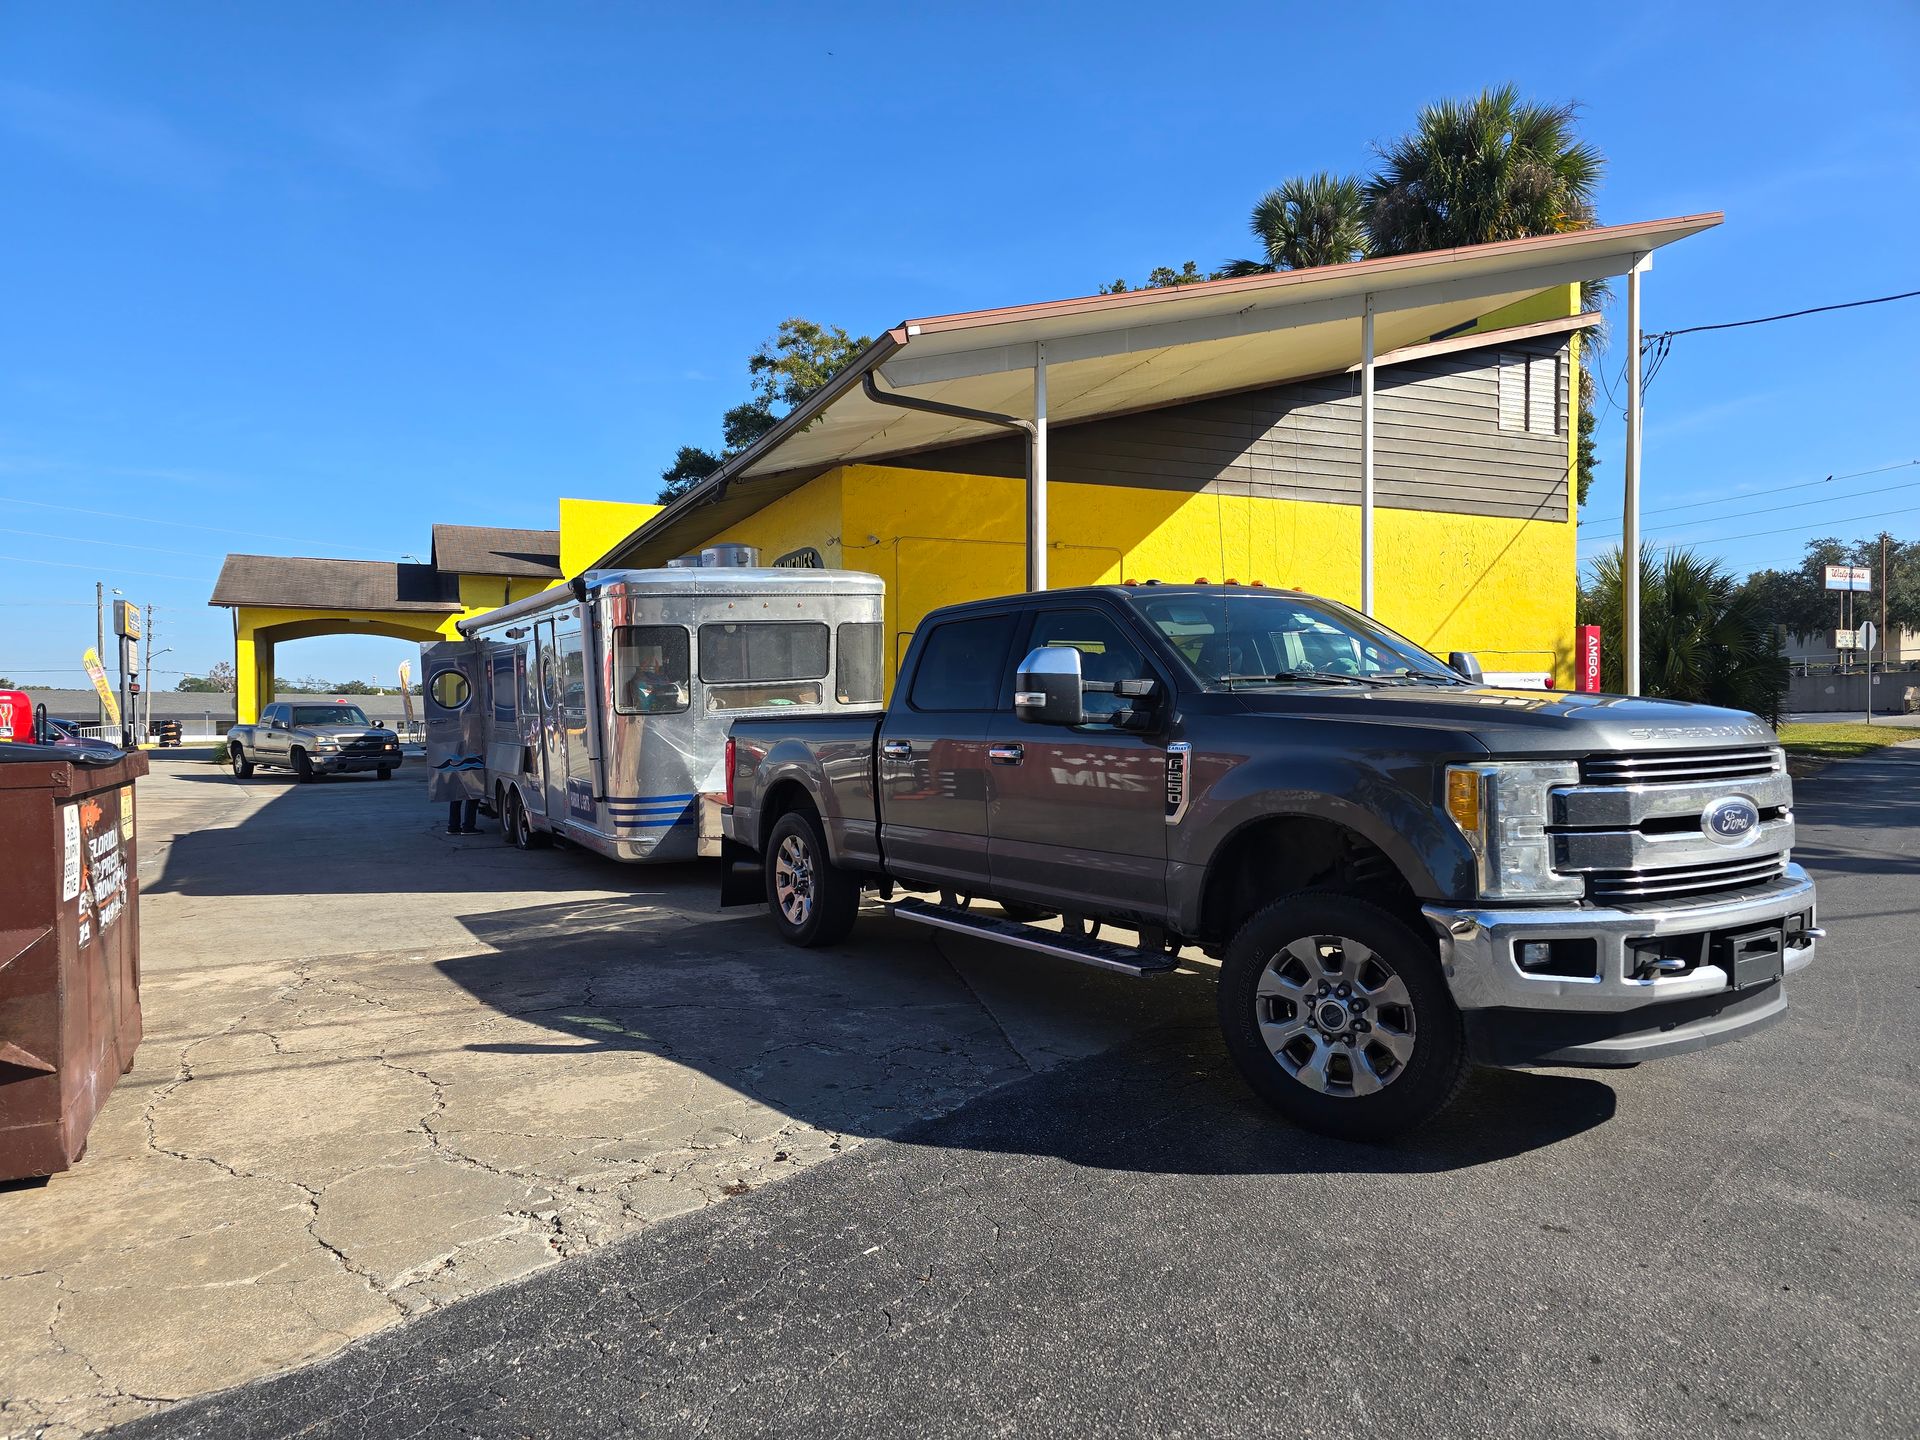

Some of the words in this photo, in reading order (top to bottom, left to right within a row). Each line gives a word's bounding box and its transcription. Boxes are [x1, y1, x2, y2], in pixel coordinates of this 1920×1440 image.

[773, 552, 813, 568] IVERIES
[1831, 569, 1865, 581] Walgreens
[1627, 727, 1717, 740] SUPER
[1722, 809, 1749, 831] Ford
